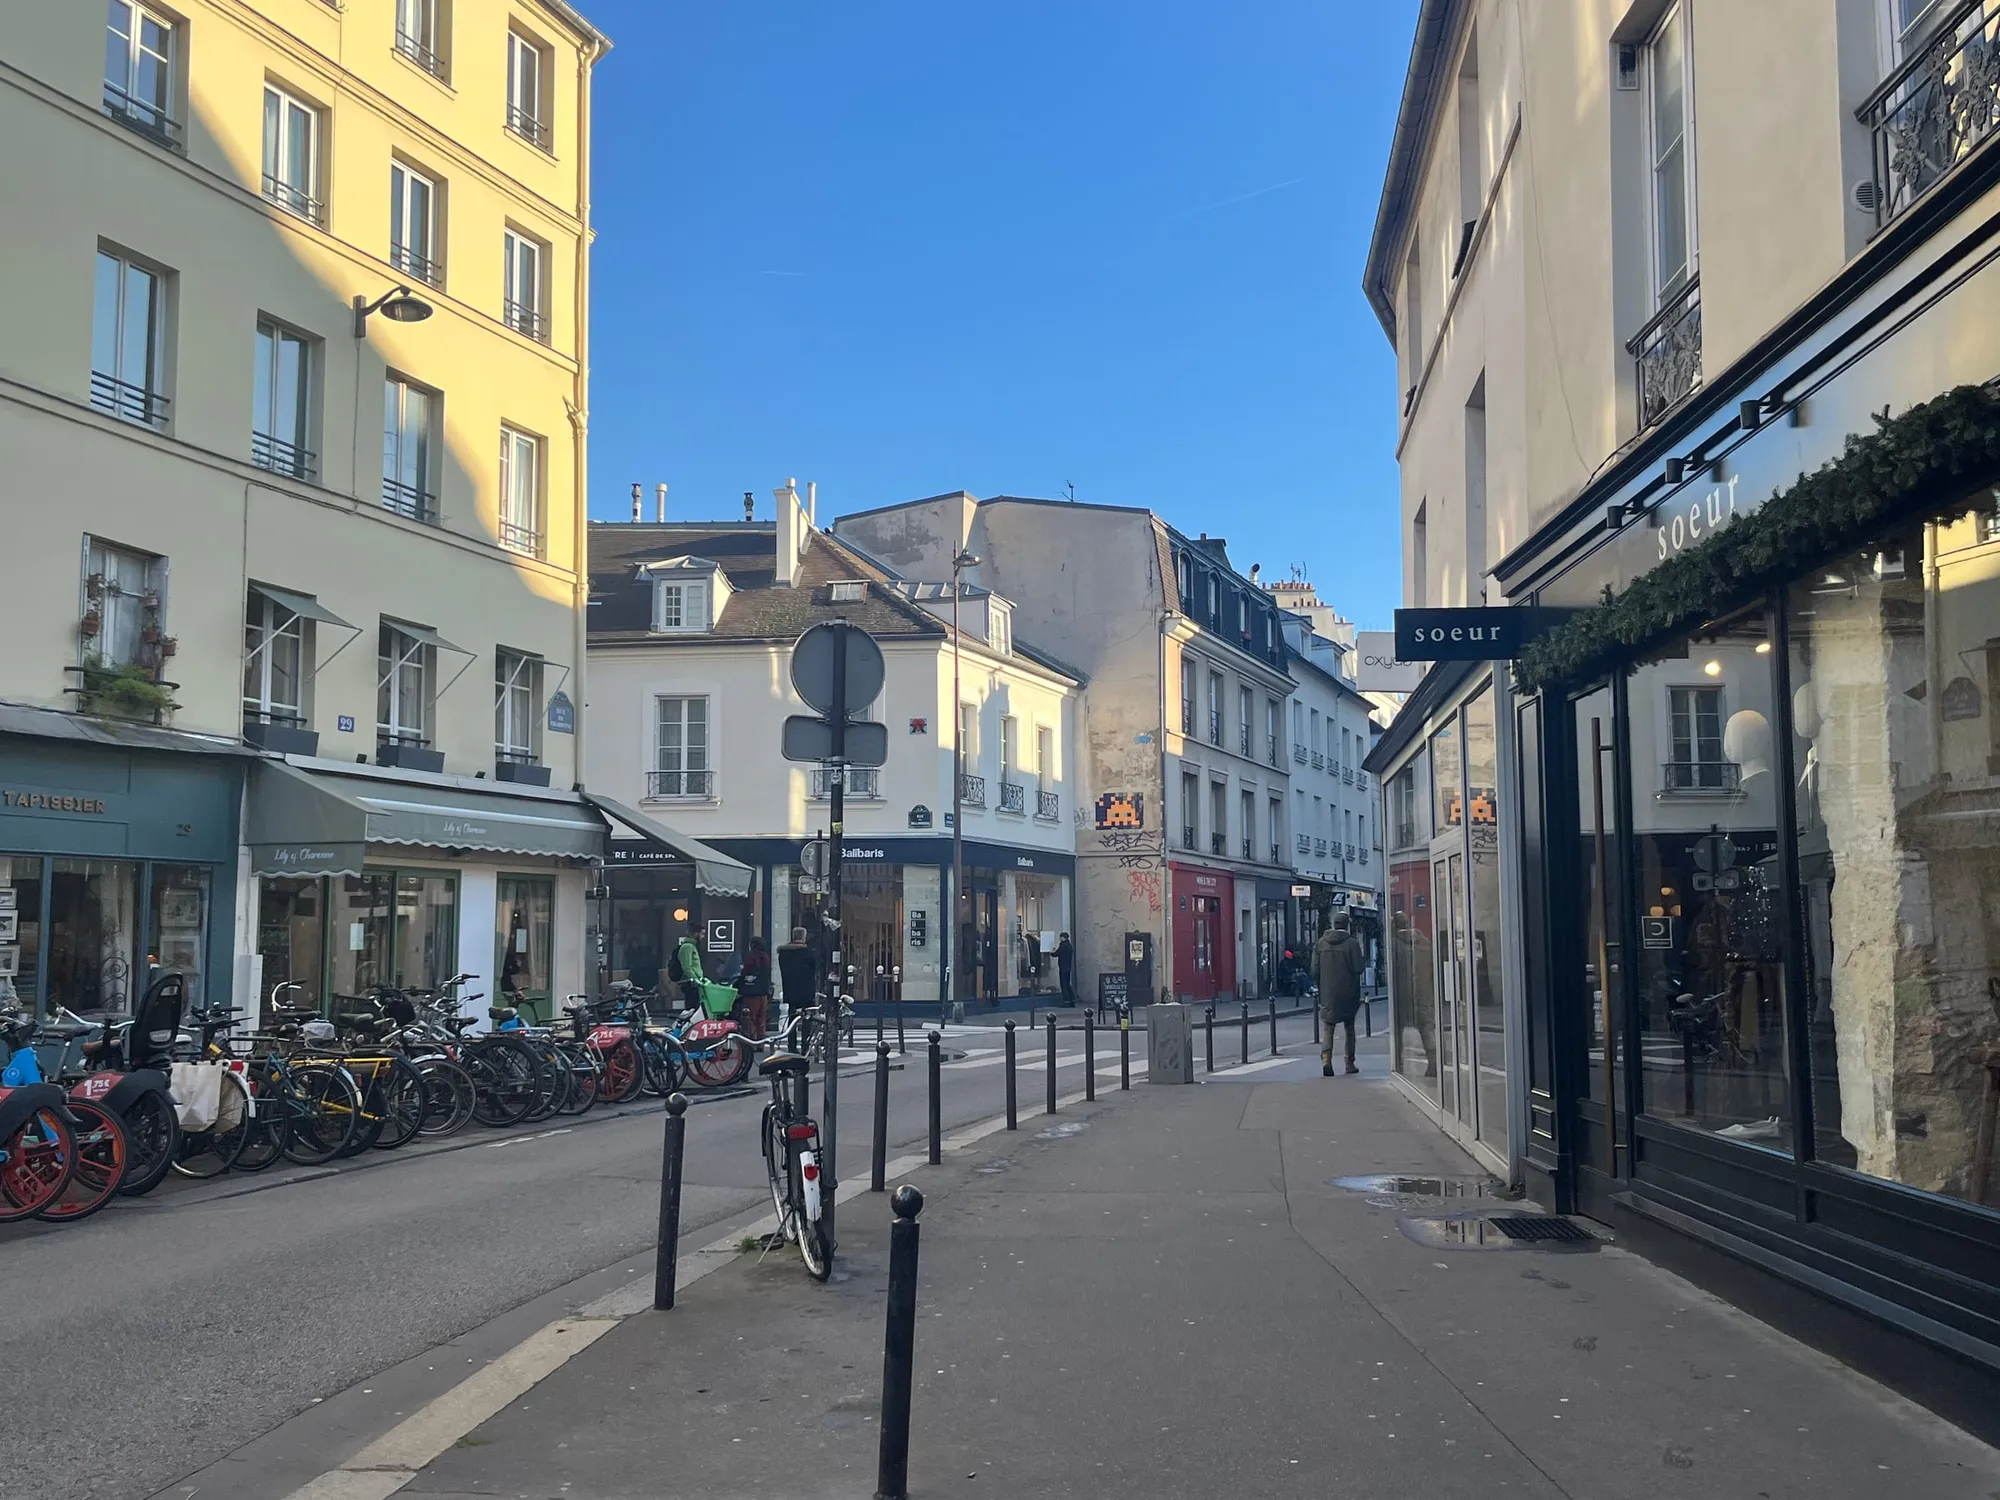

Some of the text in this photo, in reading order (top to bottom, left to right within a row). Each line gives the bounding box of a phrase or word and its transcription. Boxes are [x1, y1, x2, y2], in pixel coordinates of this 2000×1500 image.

[1658, 474, 1739, 560] soeur
[1414, 625, 1501, 642] soeur
[340, 717, 353, 730] 29
[3, 789, 105, 814] TAPISSIER
[613, 851, 627, 859] RE
[841, 848, 884, 858] Balibaris
[715, 925, 727, 939] C
